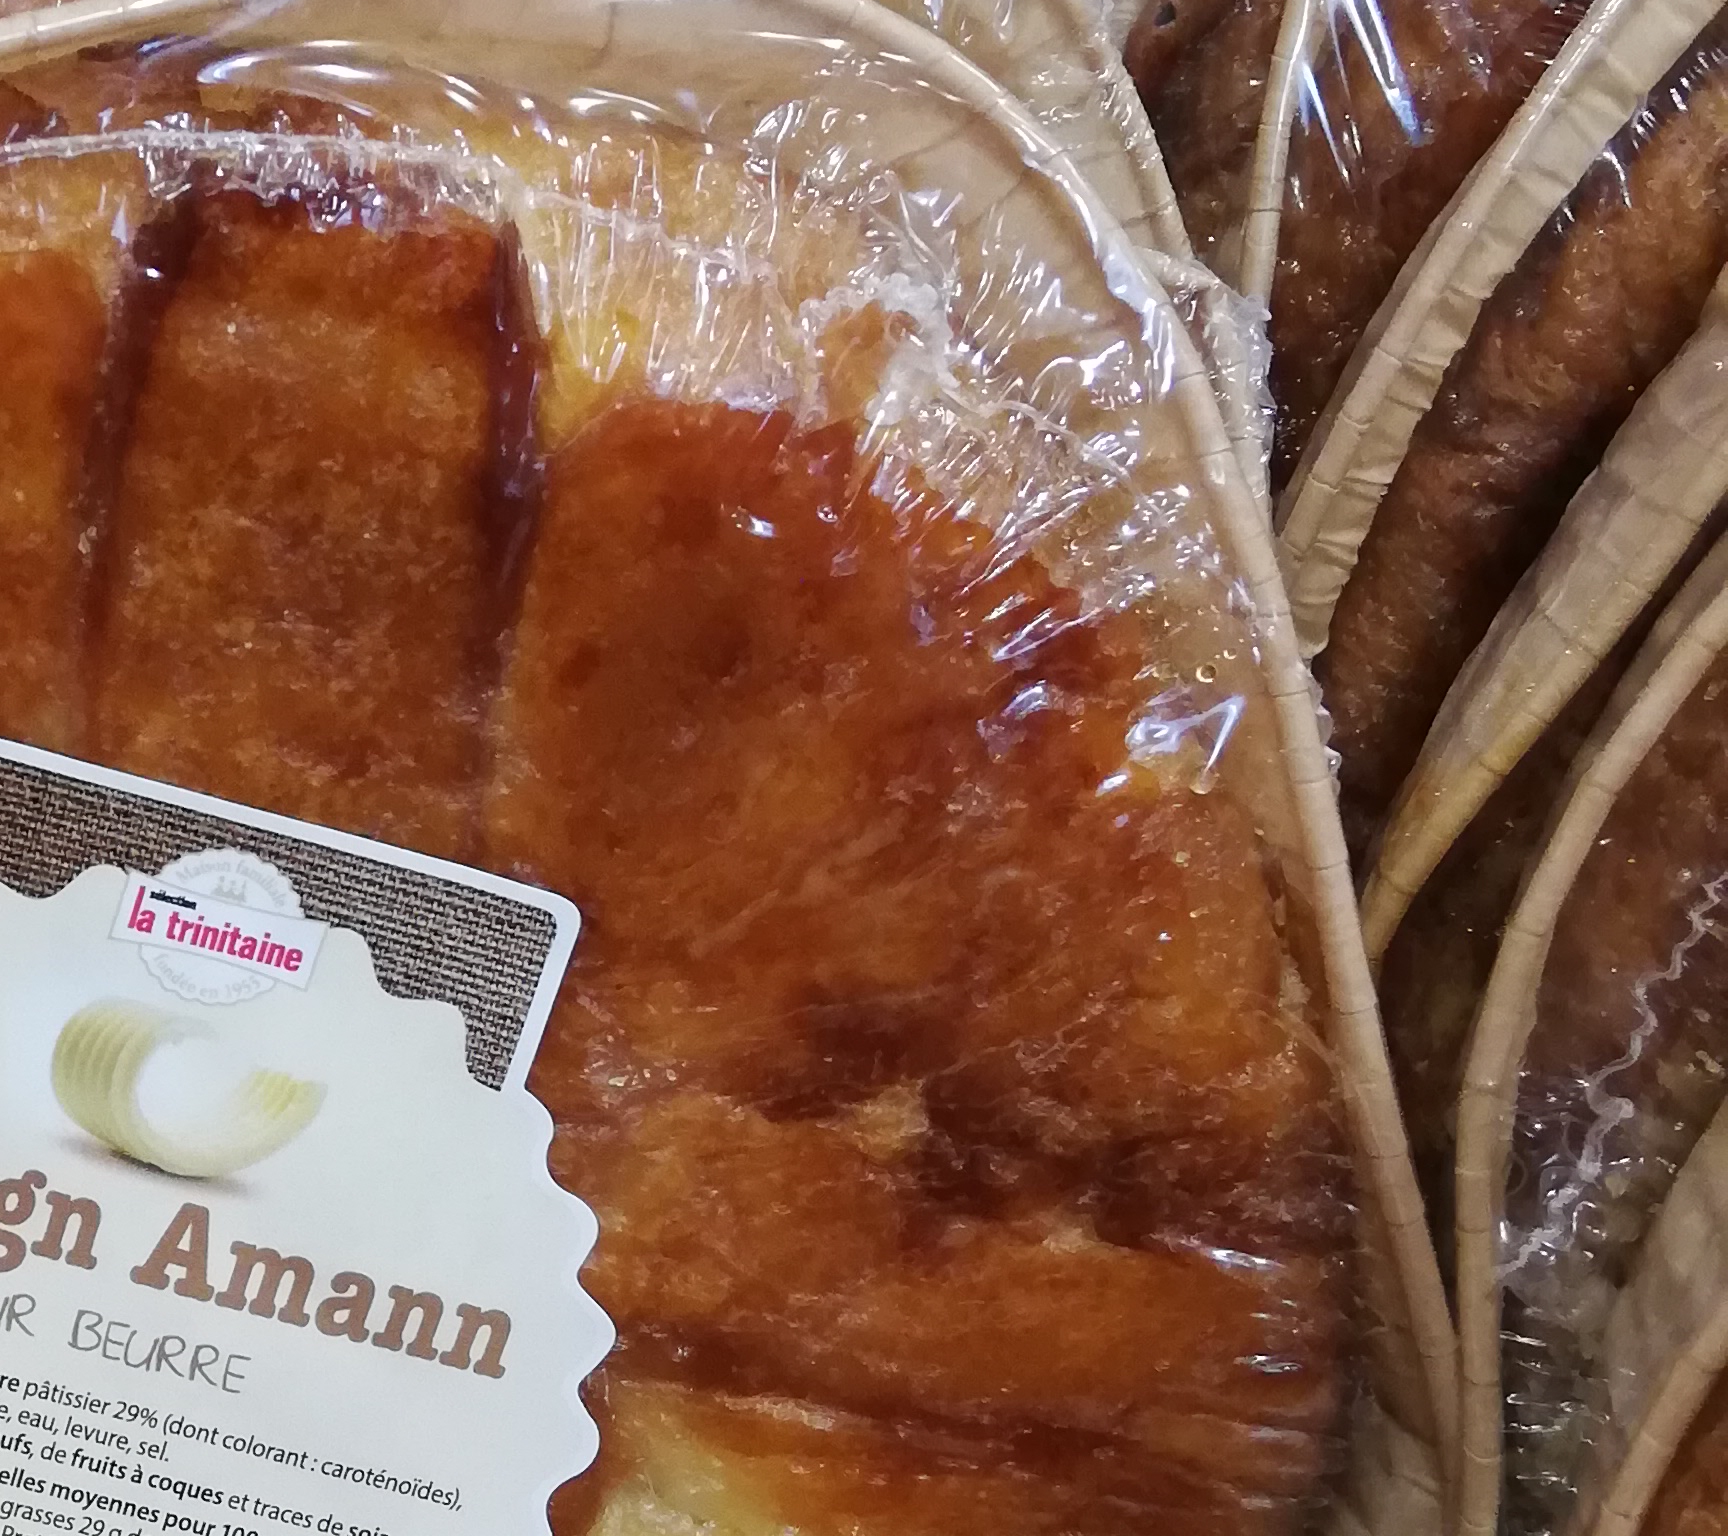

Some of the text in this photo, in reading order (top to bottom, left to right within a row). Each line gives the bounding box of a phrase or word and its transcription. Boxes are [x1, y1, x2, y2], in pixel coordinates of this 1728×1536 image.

[127, 884, 304, 972] la trinitaine
[199, 986, 219, 999] en
[130, 1201, 512, 1379] Amann
[71, 1308, 252, 1395] BEURRE
[17, 1409, 59, 1436] eau,
[63, 1414, 132, 1455] levure,
[135, 1439, 169, 1462] sel.
[21, 1379, 112, 1415] pâtissier
[111, 1400, 158, 1429] 29%
[162, 1412, 220, 1446] (dont
[320, 1460, 462, 1512] caroténoïdes),
[39, 1440, 67, 1464] de
[70, 1447, 128, 1480] fruits
[129, 1462, 143, 1484] à
[147, 1473, 224, 1505] coques
[227, 1493, 250, 1513] et
[252, 1497, 314, 1528] traces
[316, 1513, 343, 1536] de
[48, 1482, 160, 1523] moyennes
[161, 1511, 217, 1536] pour
